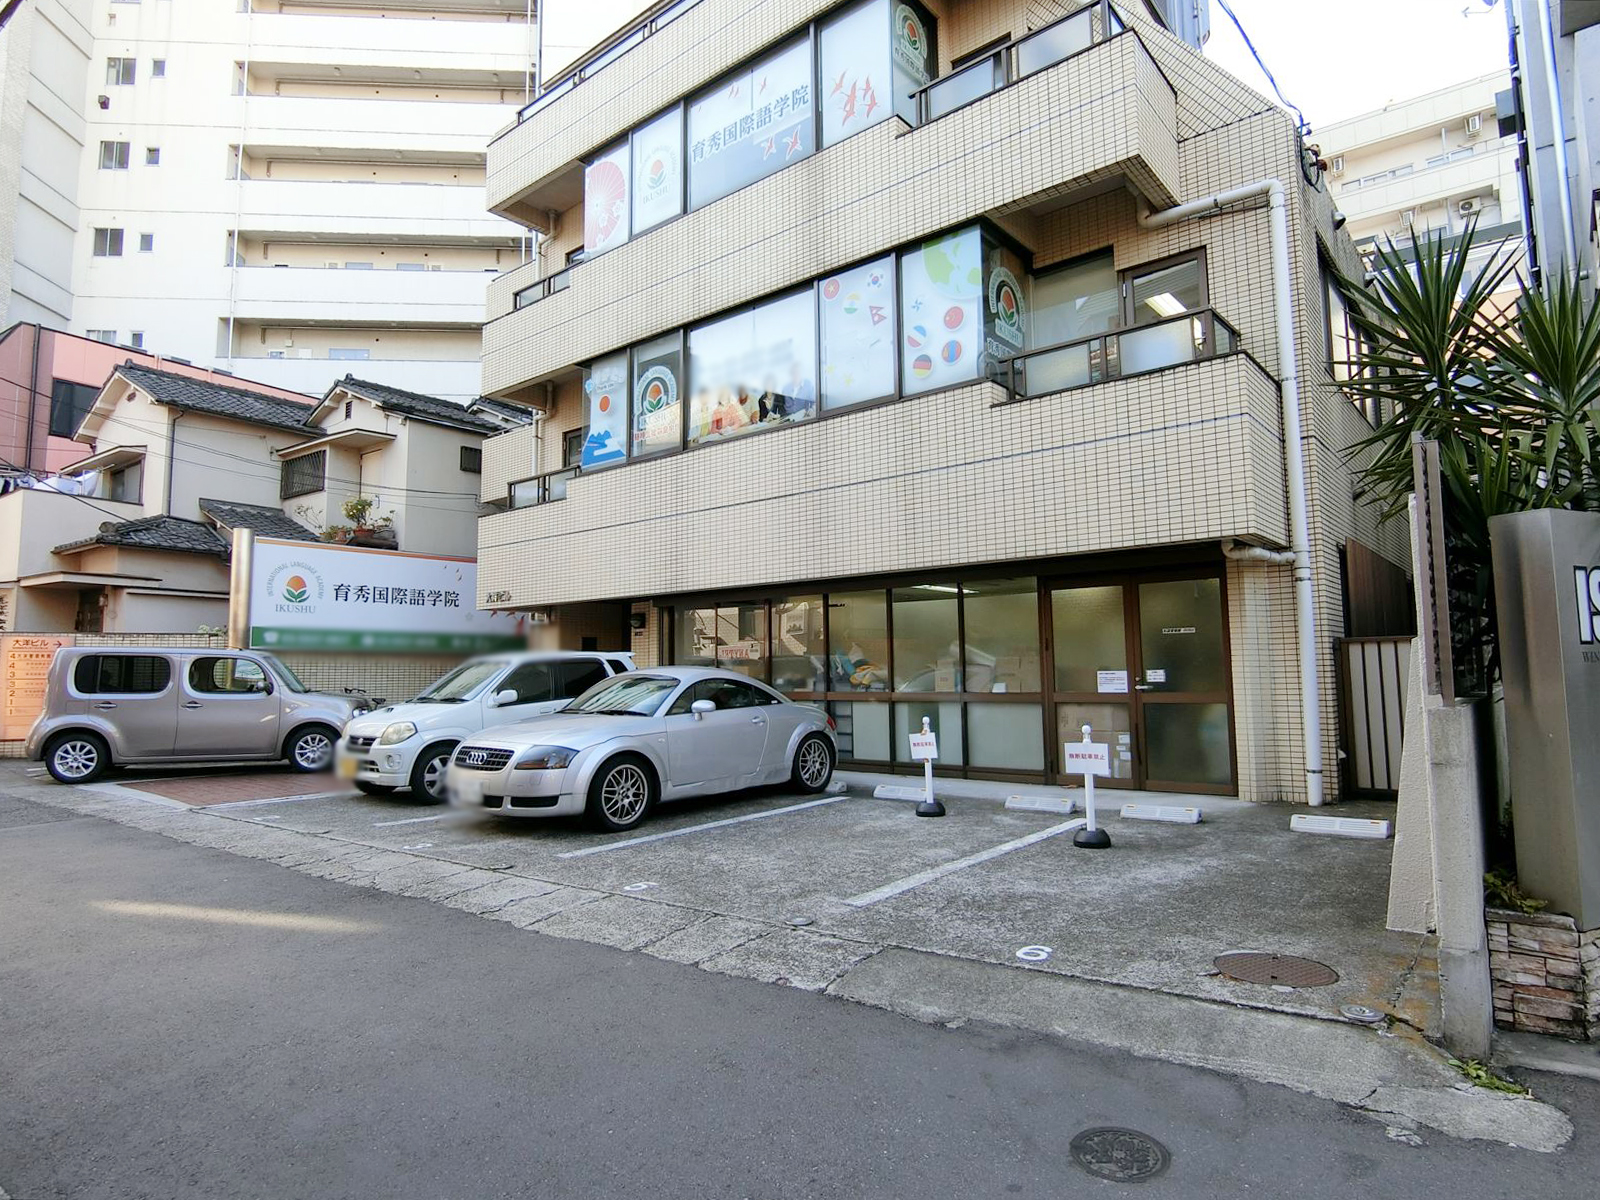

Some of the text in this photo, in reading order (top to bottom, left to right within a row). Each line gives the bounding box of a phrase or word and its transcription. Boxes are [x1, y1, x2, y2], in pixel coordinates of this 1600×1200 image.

[692, 85, 809, 163] 育秀国際語学院
[290, 561, 318, 575] LANGUAGE
[333, 583, 460, 607] 育秀国際語学院
[275, 603, 316, 614] IKUSHU
[13, 639, 49, 647] 大洋ビル
[1016, 945, 1053, 960] 6
